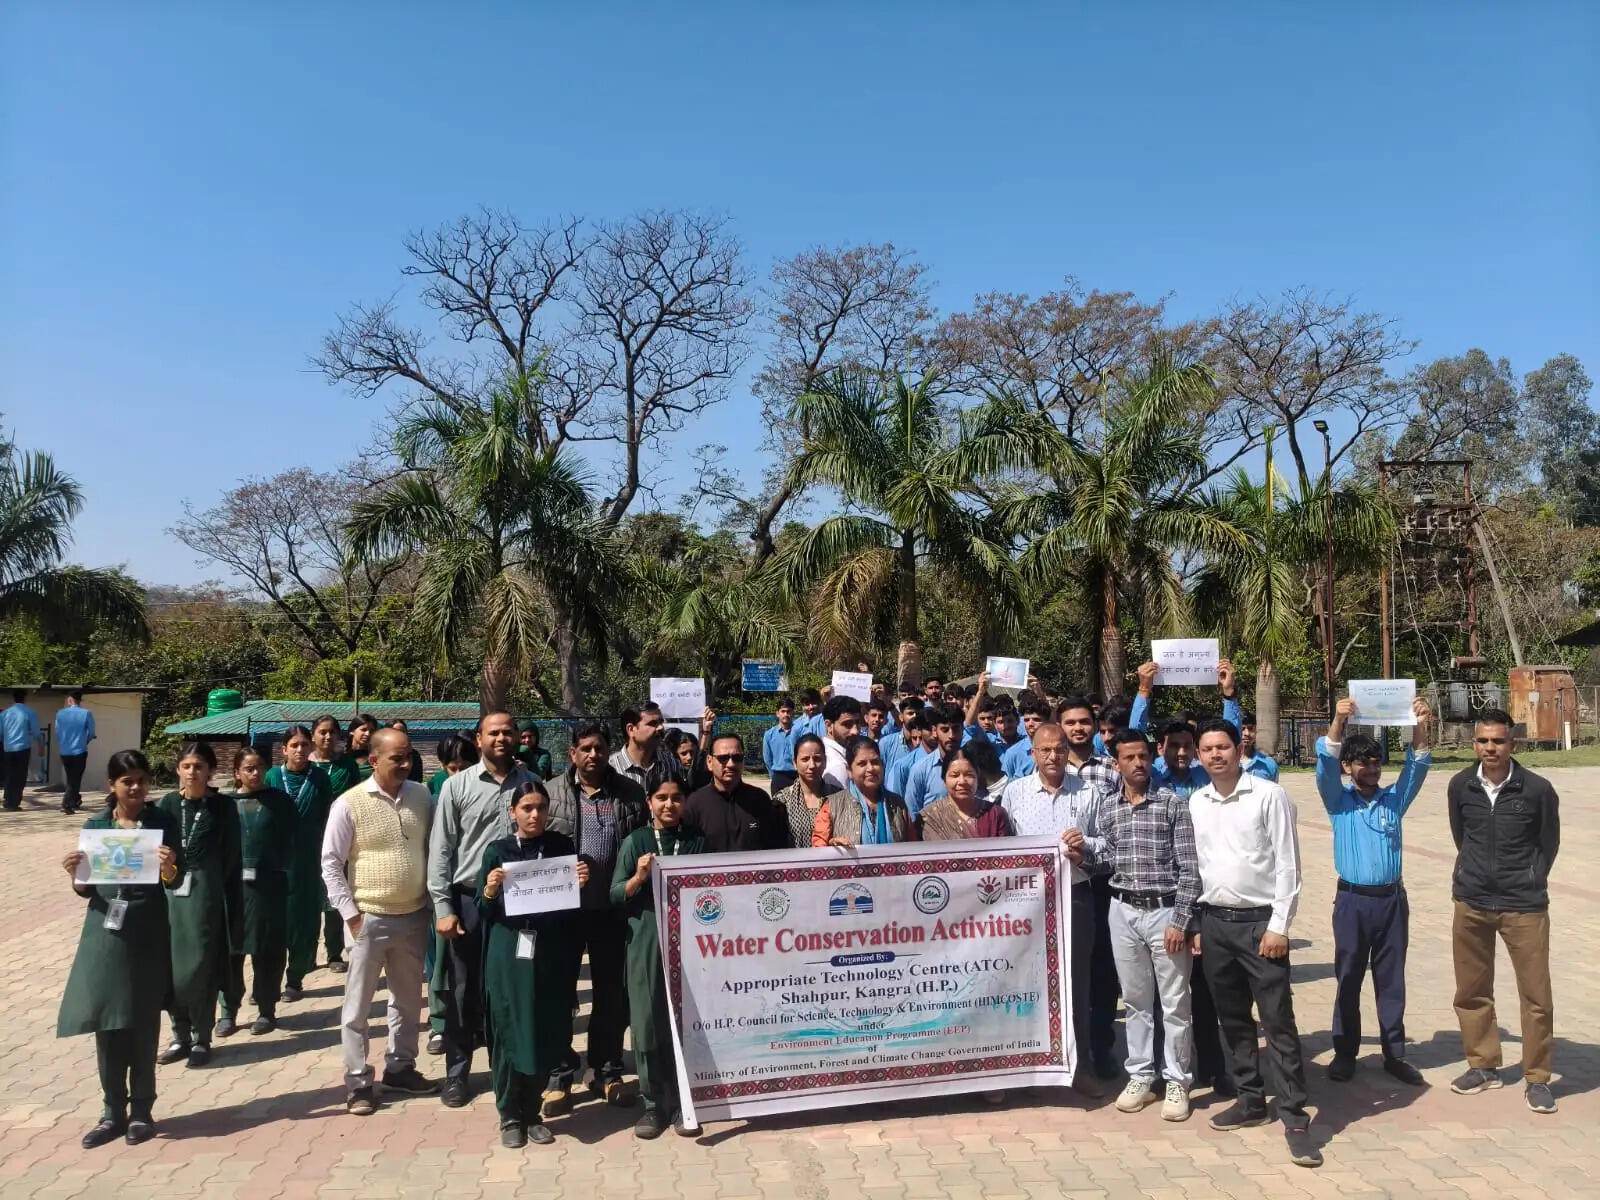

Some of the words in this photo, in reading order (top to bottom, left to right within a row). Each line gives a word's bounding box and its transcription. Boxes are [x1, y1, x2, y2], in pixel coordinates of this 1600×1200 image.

[1005, 874, 1038, 891] LiFE
[694, 932, 769, 960] Water
[774, 921, 925, 954] Conservation
[930, 913, 1033, 942] Activities
[838, 953, 875, 965] Organized
[720, 974, 817, 995] Appropriate
[820, 967, 904, 985] Technology
[909, 963, 960, 977] Centre
[855, 984, 911, 1000] Kangra
[915, 979, 959, 995] (H.P.)
[714, 1018, 736, 1030] H.P.
[738, 1014, 777, 1028] Council
[780, 1012, 796, 1024] for
[799, 1010, 837, 1023] Science,
[841, 1004, 894, 1019] Technology
[896, 1002, 907, 1014] &
[909, 999, 973, 1013] Environment
[974, 991, 1040, 1009] (HIMCOSTE)
[770, 1036, 833, 1050] Environment
[836, 1031, 883, 1045] Education
[886, 1028, 941, 1042] Programme
[943, 1024, 972, 1037] (EEP)
[857, 1021, 885, 1032] under
[694, 1068, 736, 1082] Ministry
[738, 1065, 749, 1077] of
[751, 1060, 817, 1075] Environment,
[819, 1057, 849, 1068] Forest
[851, 1056, 869, 1066] and
[872, 1052, 909, 1064] Climate
[911, 1050, 946, 1062] Change
[948, 1044, 1004, 1057] Government
[1006, 1040, 1017, 1050] of
[1018, 1038, 1041, 1050] India
[868, 1044, 877, 1053] of
